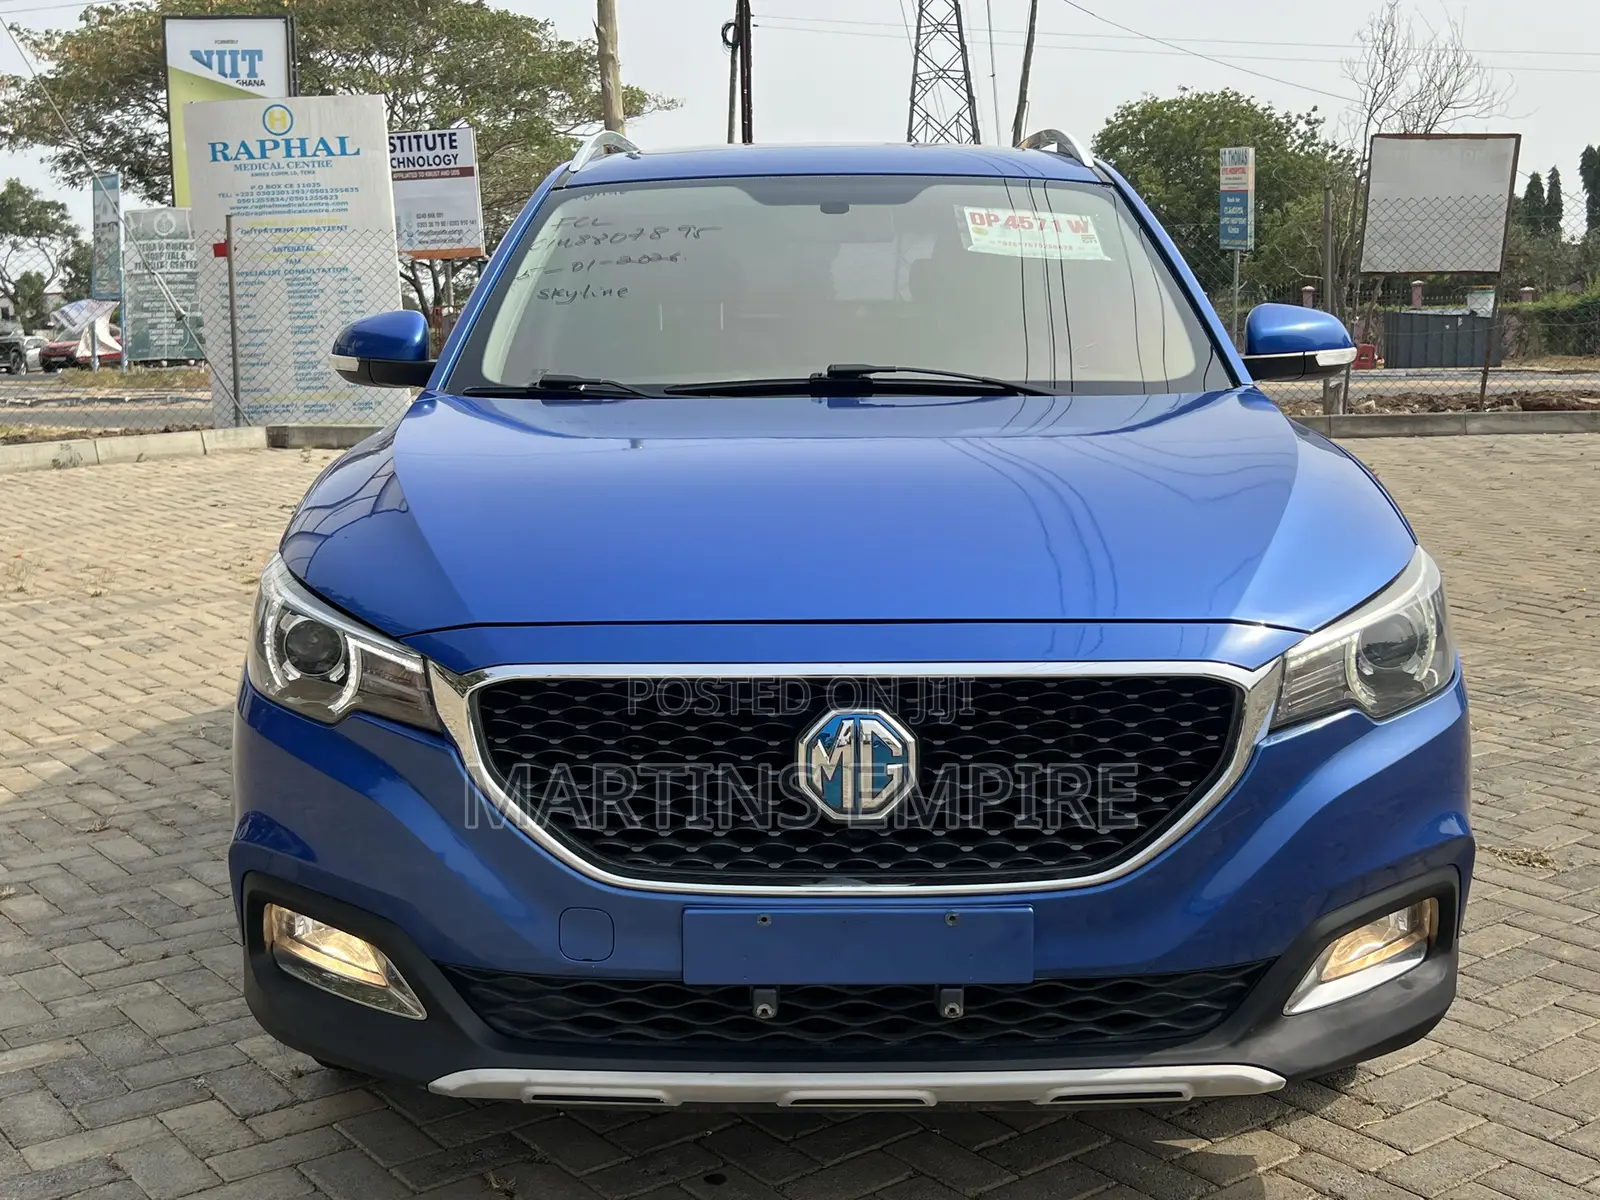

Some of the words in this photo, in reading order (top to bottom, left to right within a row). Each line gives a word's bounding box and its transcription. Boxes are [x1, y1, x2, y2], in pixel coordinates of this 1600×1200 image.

[207, 135, 361, 163] RAPHAL
[388, 132, 458, 154] STITUTE
[233, 162, 285, 172] MEDICAL
[286, 160, 333, 170] CENTRE
[390, 153, 459, 169] CHNOLOGY
[969, 211, 1000, 228] DP
[1003, 215, 1062, 233] 4571
[1066, 219, 1090, 234] W
[272, 244, 316, 253] ANTENATAL
[283, 266, 349, 276] CONSULTATION
[810, 718, 904, 810] MG
